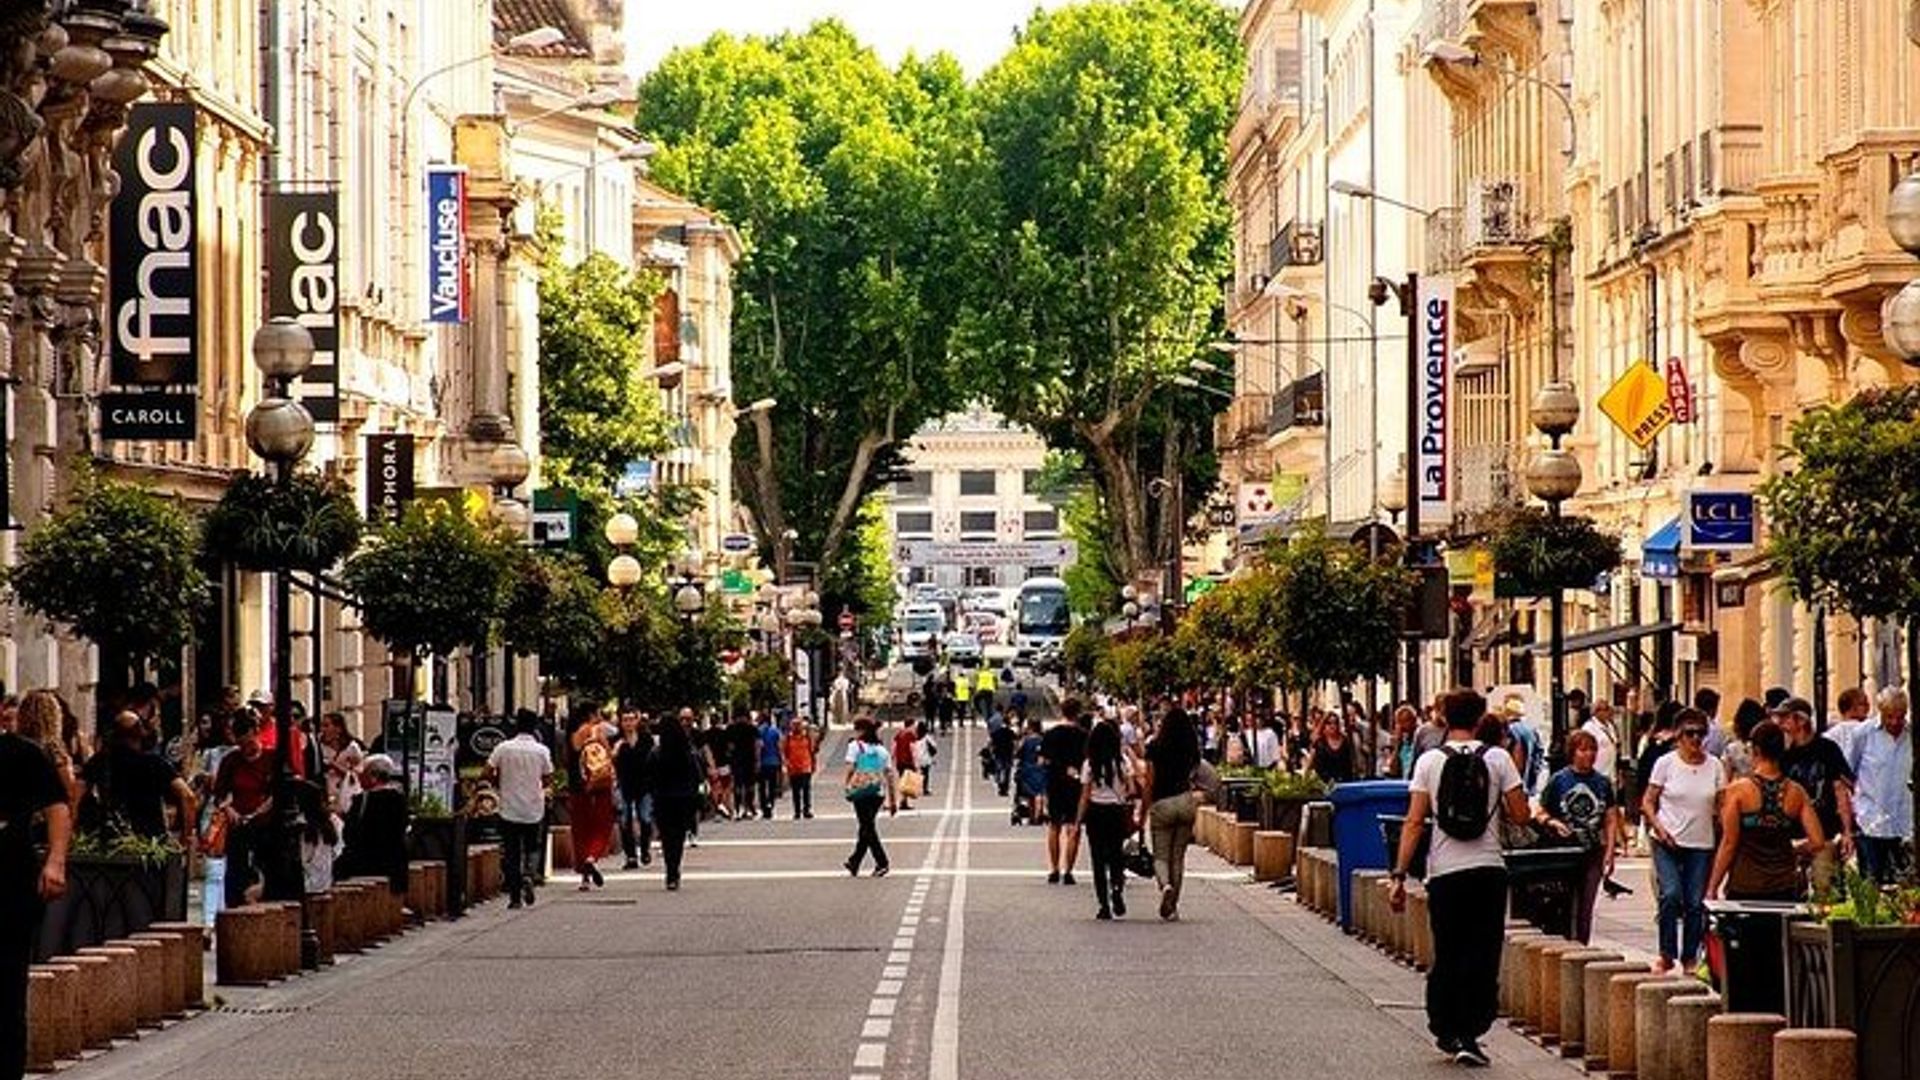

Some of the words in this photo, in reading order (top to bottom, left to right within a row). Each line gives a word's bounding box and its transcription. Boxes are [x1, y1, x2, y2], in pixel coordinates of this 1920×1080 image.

[117, 124, 191, 361] fnac
[432, 198, 458, 315] Vaucluse
[1422, 298, 1444, 455] Provence
[1668, 359, 1687, 421] TABAC
[111, 409, 185, 424] CAROLL
[382, 439, 398, 525] EPHORA
[1422, 465, 1444, 502] La
[1695, 503, 1745, 520] LCL
